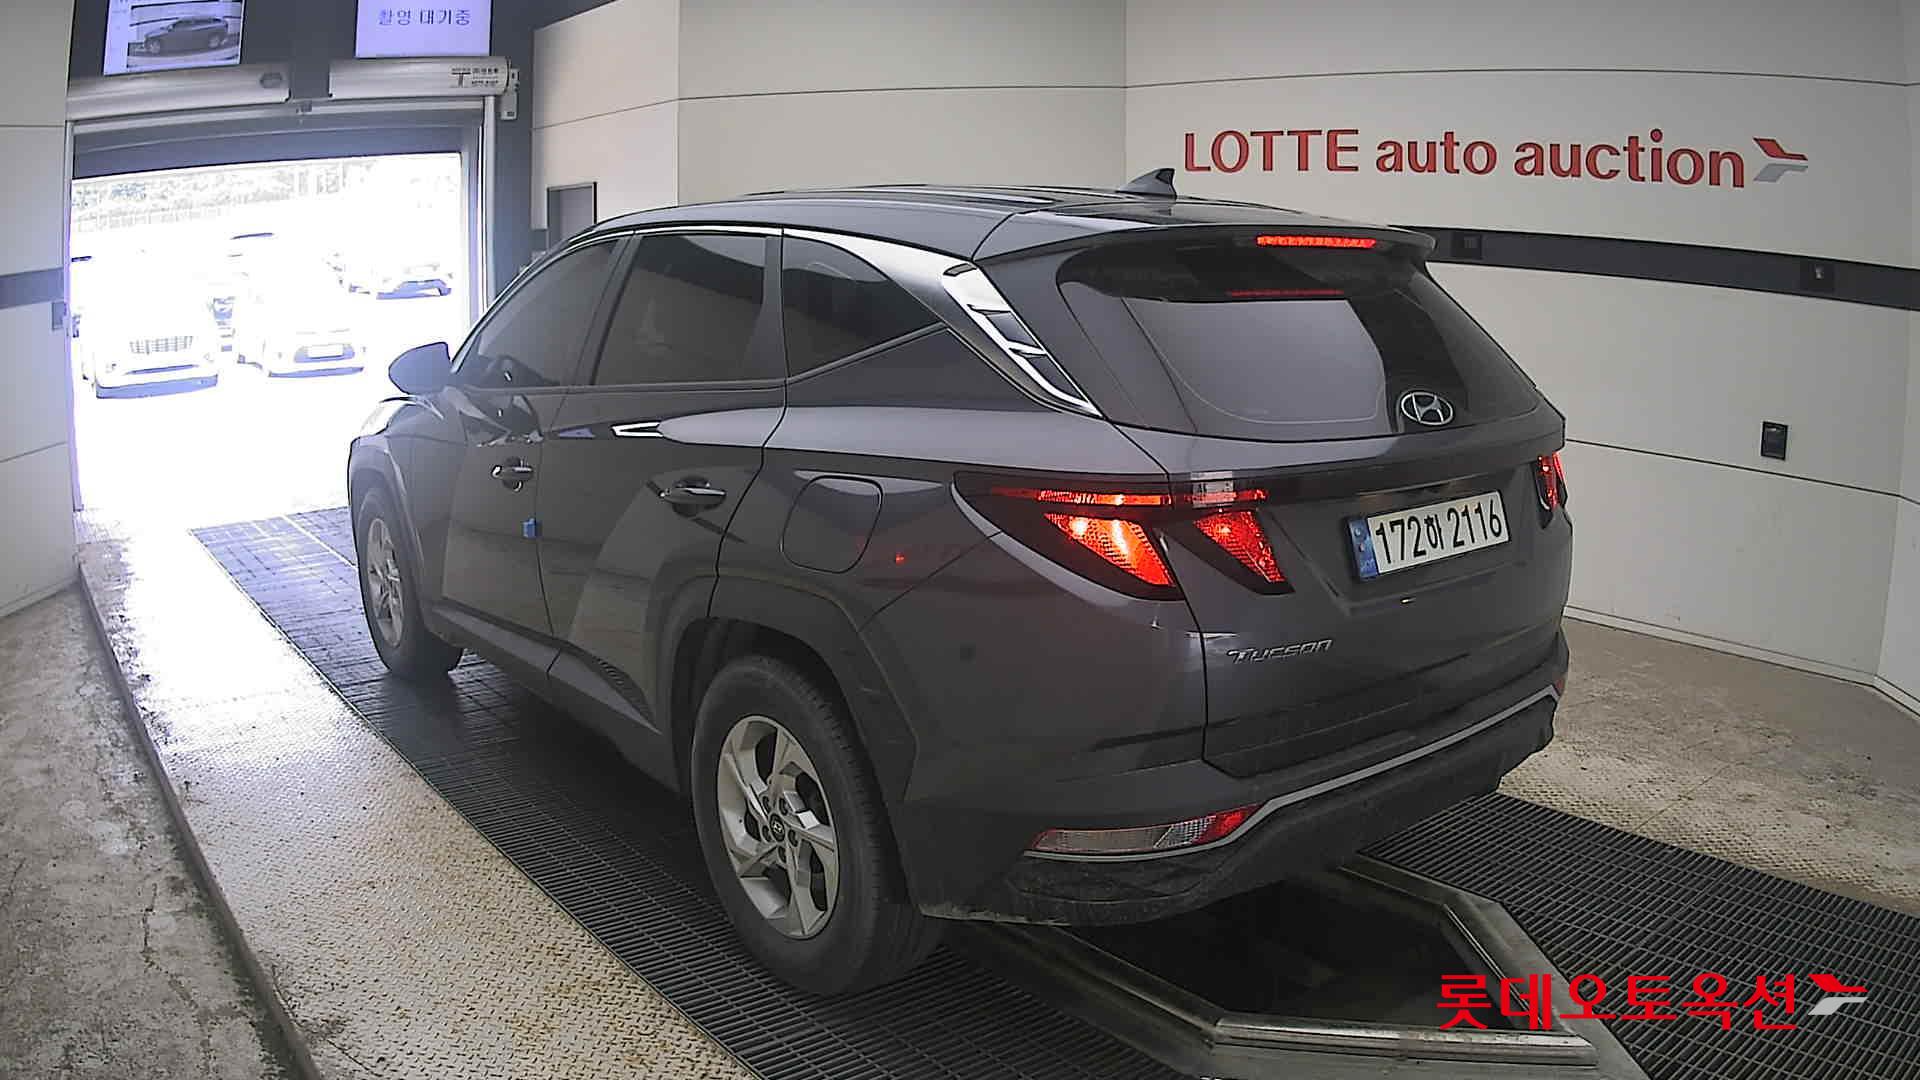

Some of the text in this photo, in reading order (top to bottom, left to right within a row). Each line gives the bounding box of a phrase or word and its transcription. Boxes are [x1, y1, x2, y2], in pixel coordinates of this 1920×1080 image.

[420, 9, 471, 26] 대기중
[1184, 128, 1744, 188] LOTTE auto auction
[1447, 499, 1502, 548] 2116
